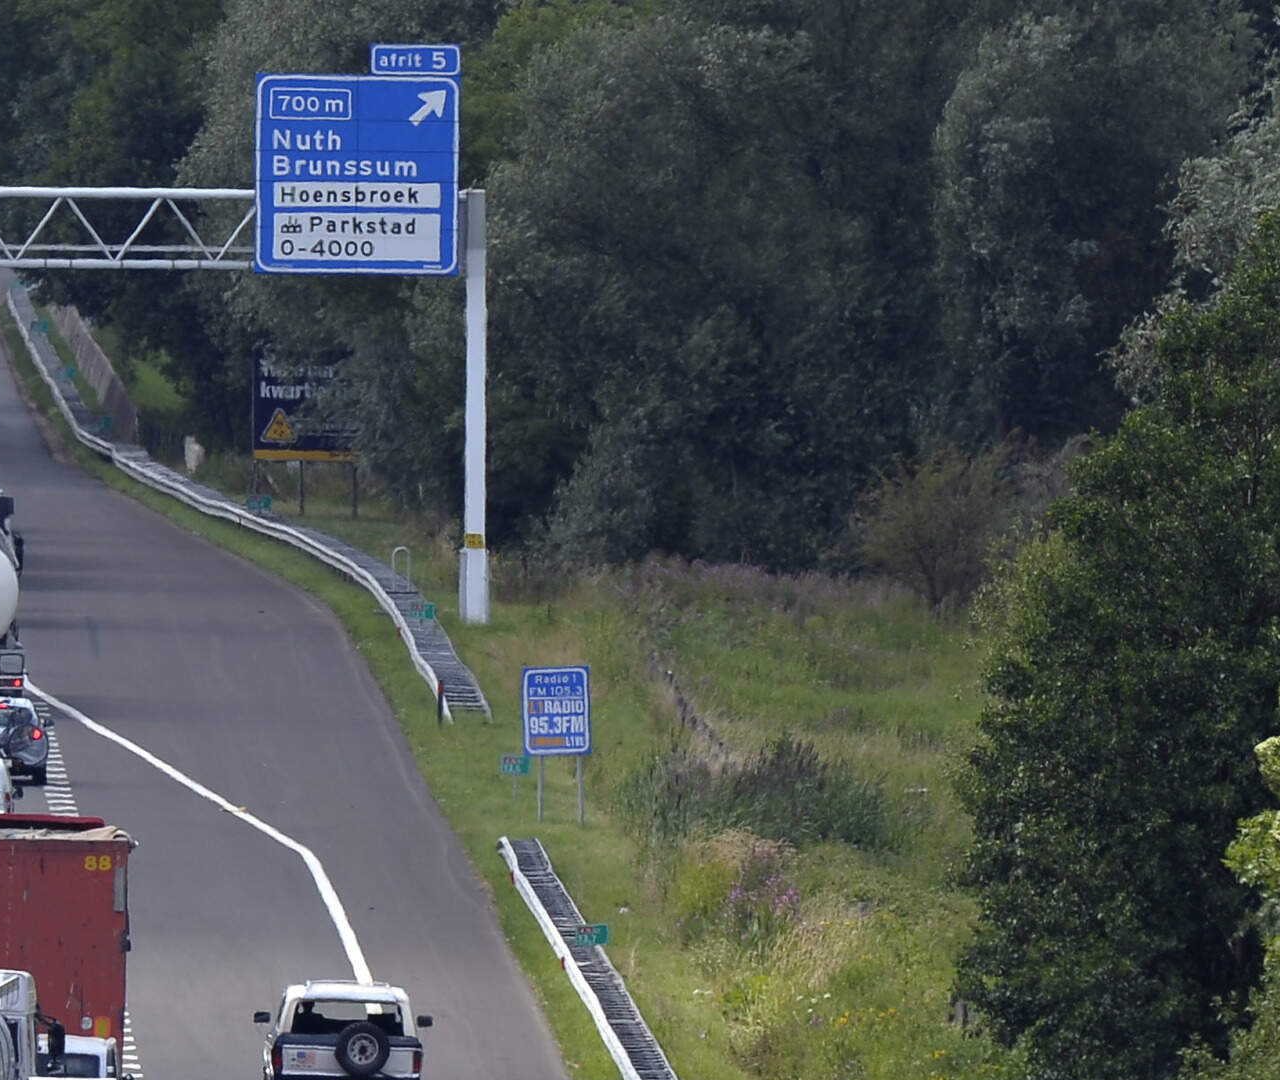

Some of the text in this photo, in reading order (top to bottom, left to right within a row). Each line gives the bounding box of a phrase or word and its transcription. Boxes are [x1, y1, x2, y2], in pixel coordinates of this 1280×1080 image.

[379, 51, 447, 69] afrit 5
[277, 94, 344, 113] 700 m
[272, 128, 342, 151] Nuth
[272, 155, 418, 177] Brunssum
[280, 185, 420, 204] Hoensbroek
[309, 215, 417, 236] Parkstad
[280, 239, 375, 258] 0-4000
[535, 675, 569, 684] Radio
[529, 687, 547, 697] FM
[84, 855, 112, 870] 88
